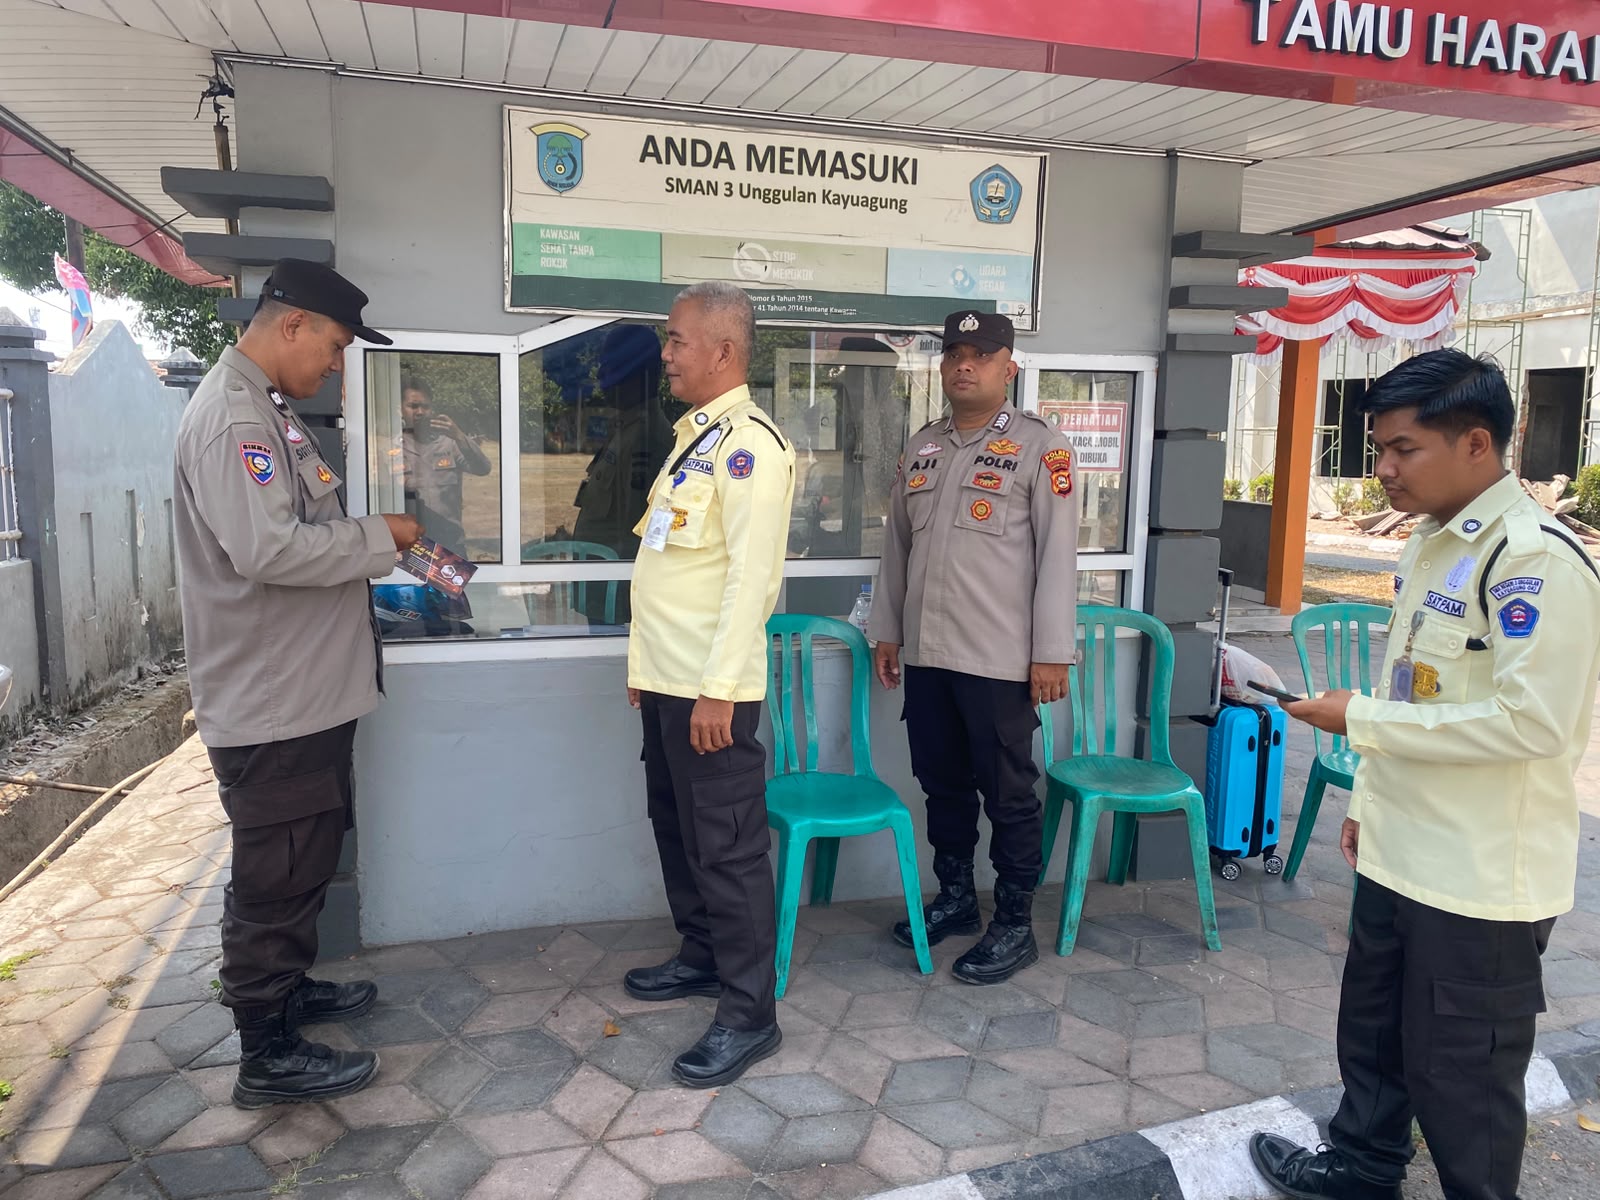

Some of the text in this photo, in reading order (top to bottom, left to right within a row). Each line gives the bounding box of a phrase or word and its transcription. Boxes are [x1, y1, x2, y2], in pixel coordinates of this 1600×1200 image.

[1251, 0, 1600, 82] TAMU HARA
[639, 134, 919, 186] ANDA MEMASUKI
[665, 177, 909, 214] SMAN 3 Unggulan Kayuagung
[540, 228, 581, 241] KAWASAN
[568, 244, 595, 257] TANPA
[772, 250, 797, 264] STOP
[540, 256, 569, 269] ROKOK
[777, 295, 796, 303] Tahun
[797, 295, 813, 303] 2015
[767, 305, 787, 313] Tahun
[804, 306, 829, 316] tentang
[1063, 413, 1119, 427] PERHATIAN
[910, 458, 938, 472] AJI
[973, 455, 1018, 472] POLRI
[1079, 452, 1108, 464] DIBUKA
[1427, 595, 1462, 615] SATPAM
